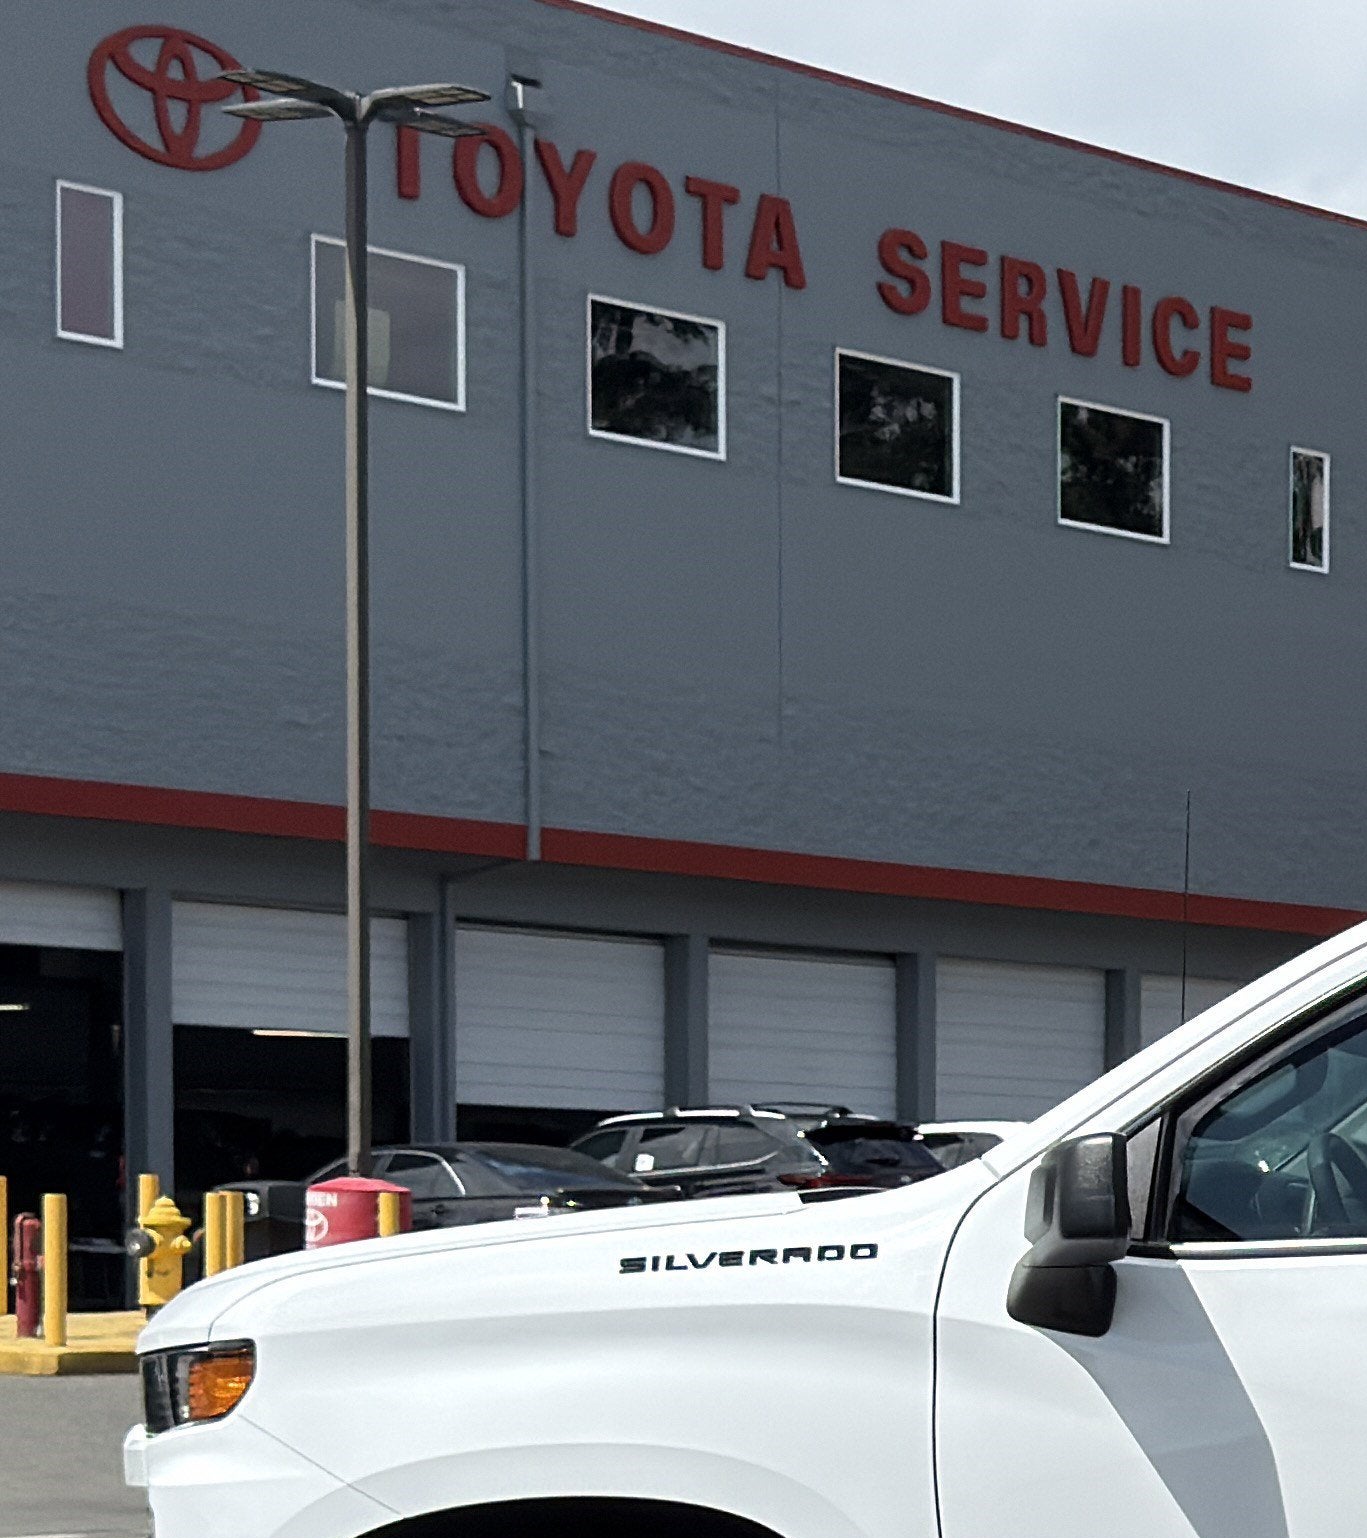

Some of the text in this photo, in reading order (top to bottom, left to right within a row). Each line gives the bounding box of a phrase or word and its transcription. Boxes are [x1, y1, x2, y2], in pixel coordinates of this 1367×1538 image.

[396, 122, 1252, 392] TOYOTA SERVICE
[619, 1243, 878, 1274] SILVERADO
